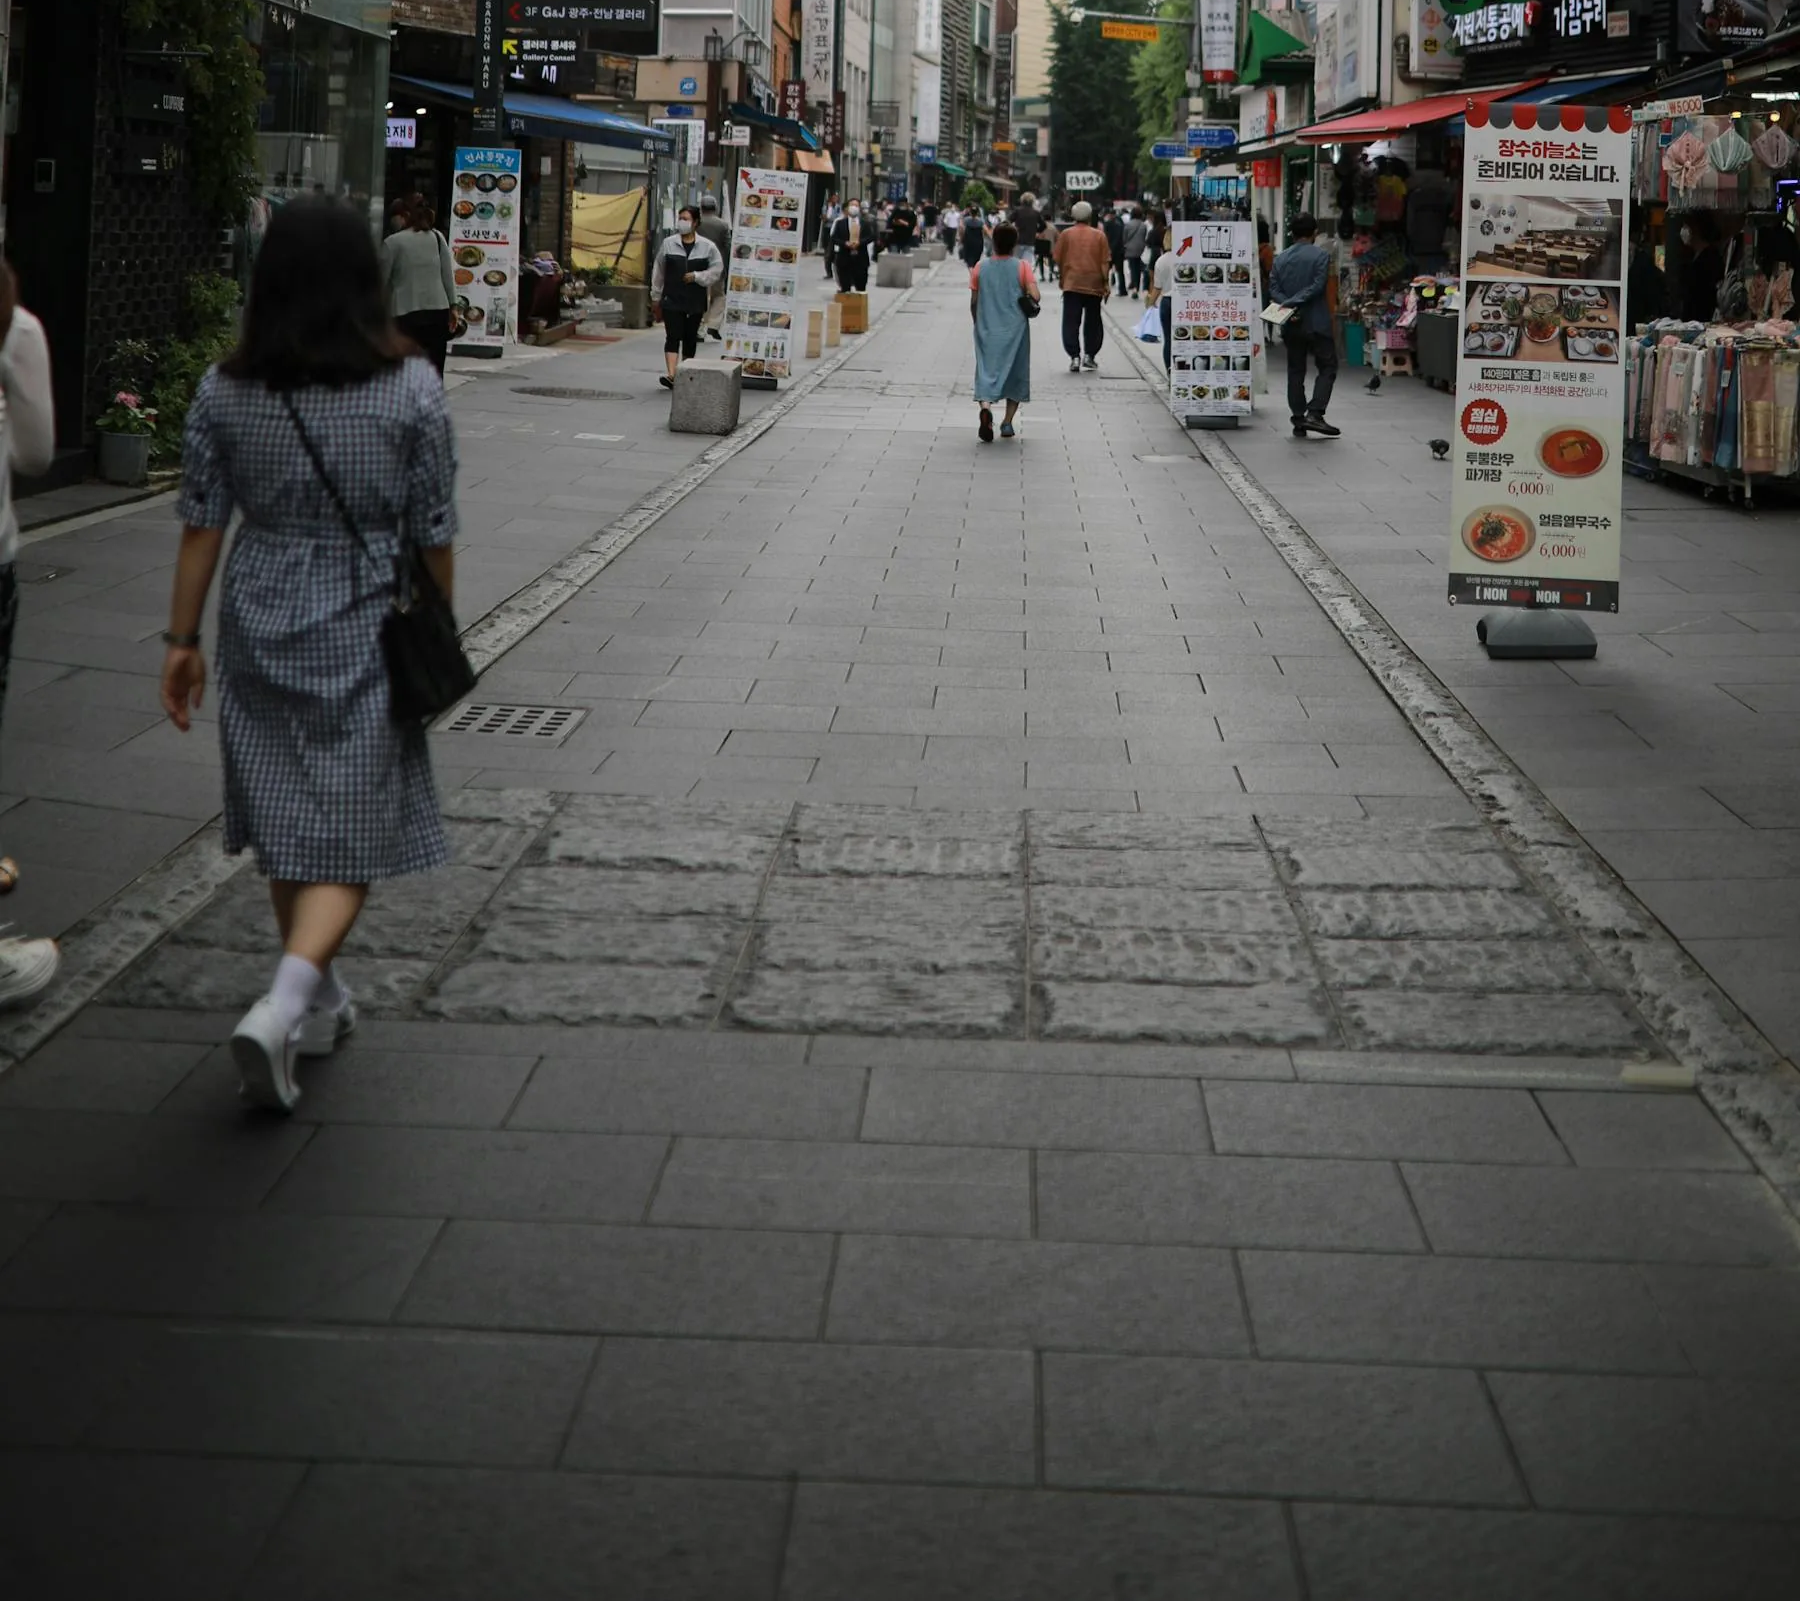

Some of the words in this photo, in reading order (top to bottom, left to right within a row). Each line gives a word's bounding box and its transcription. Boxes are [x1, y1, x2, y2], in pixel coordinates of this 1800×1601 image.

[524, 6, 538, 17] 3F
[542, 6, 566, 19] G&J
[522, 54, 549, 62] Gallery
[482, 56, 490, 88] MARU
[1498, 140, 1598, 160] 장수하늘소는
[1478, 160, 1543, 180] 준비되어
[1549, 164, 1620, 183] 있습니다.
[1238, 250, 1246, 258] 2F
[1214, 300, 1237, 310] 국내산
[1222, 311, 1247, 322] 전문점
[1470, 407, 1498, 424] 점심
[1464, 468, 1502, 483] 파개장
[1539, 513, 1612, 530] 얼음열무국수
[1483, 587, 1507, 601] NON
[1536, 590, 1560, 604] NON
